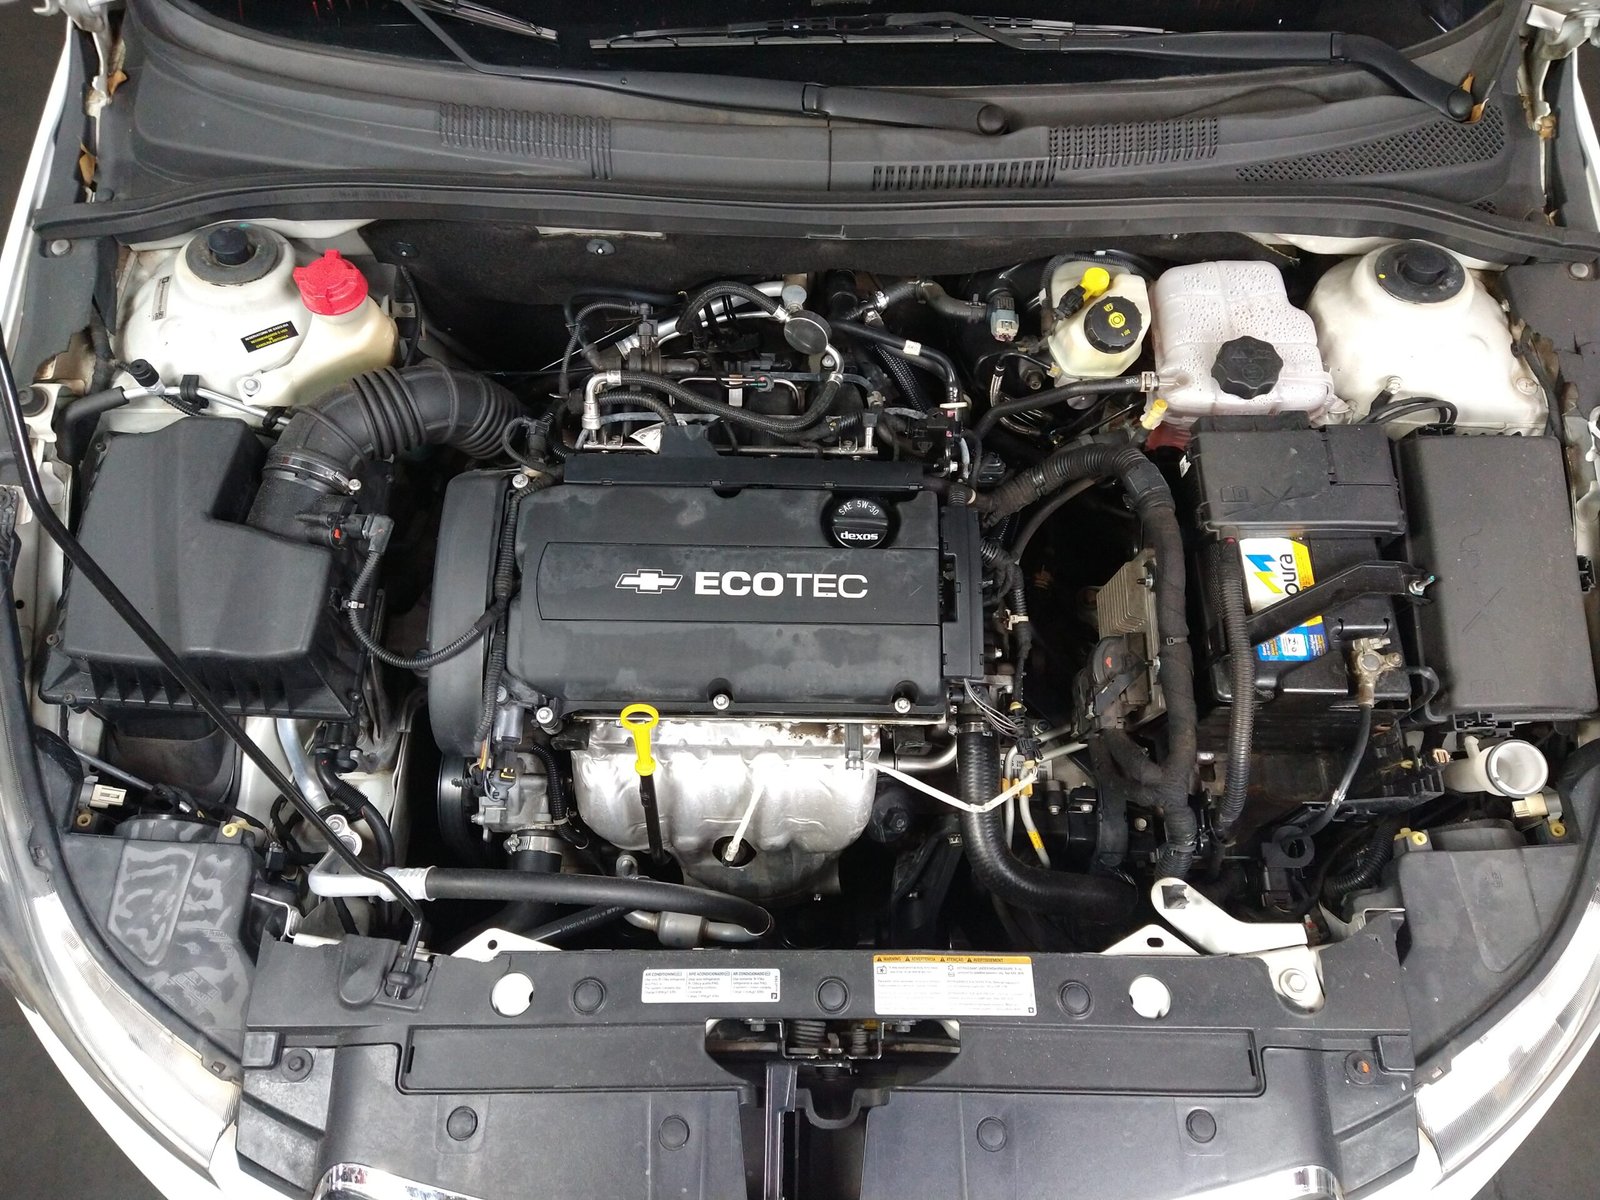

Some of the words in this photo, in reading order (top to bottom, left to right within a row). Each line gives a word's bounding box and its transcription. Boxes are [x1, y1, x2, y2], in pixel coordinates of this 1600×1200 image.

[838, 501, 853, 516] SAE
[856, 500, 880, 516] 5W-30
[840, 530, 879, 541] dexos
[694, 570, 868, 599] ECOTEC
[1279, 553, 1300, 596] oura
